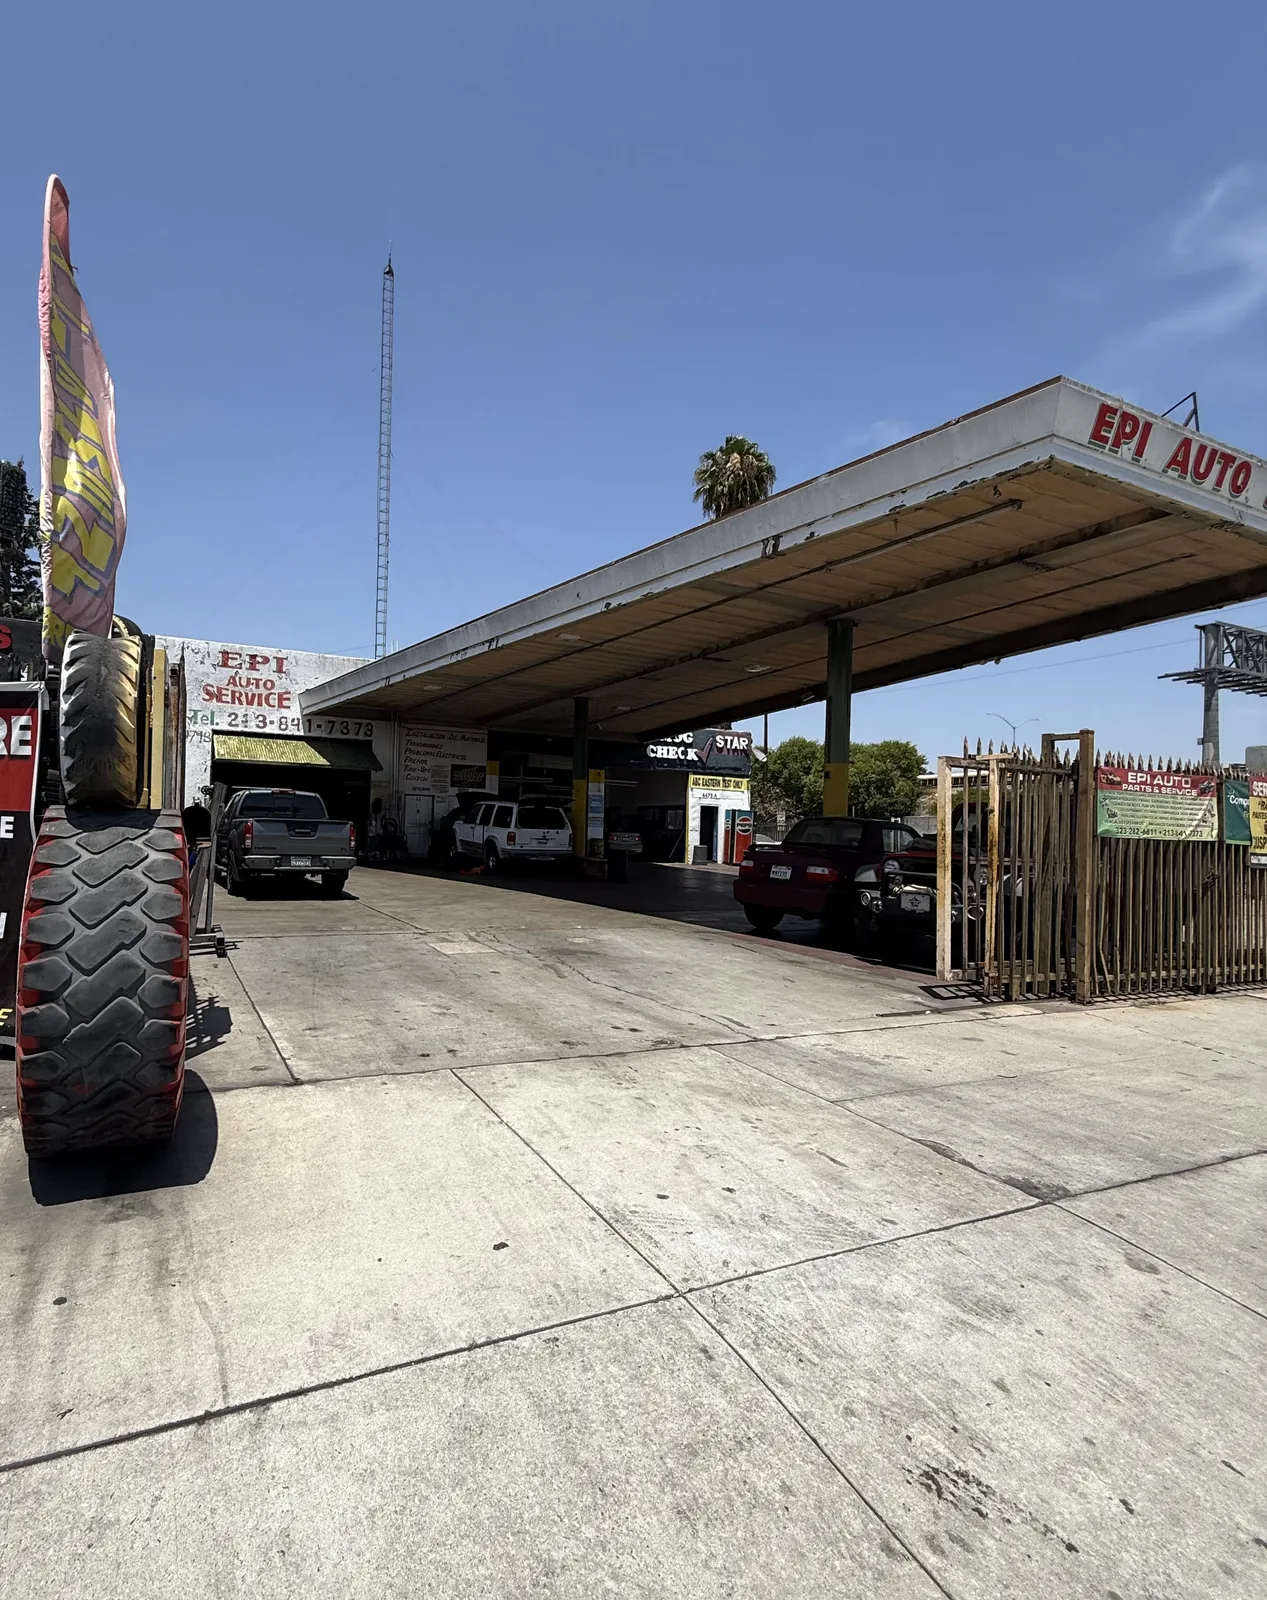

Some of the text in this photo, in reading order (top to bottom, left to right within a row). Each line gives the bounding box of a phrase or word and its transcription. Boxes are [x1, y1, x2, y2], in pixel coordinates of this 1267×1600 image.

[1088, 403, 1252, 499] EPI AUTO
[218, 649, 288, 674] EPI
[226, 675, 276, 691] AUTO
[202, 683, 292, 709] SERVICE
[188, 709, 220, 727] Tel.
[715, 735, 749, 750] STAR
[646, 745, 699, 761] CHECK
[692, 777, 743, 789] ABC EASTERN TEST ONLY
[1127, 772, 1191, 788] EPI AUTO
[1122, 784, 1152, 792] PARTS
[1161, 787, 1198, 796] SERVICE
